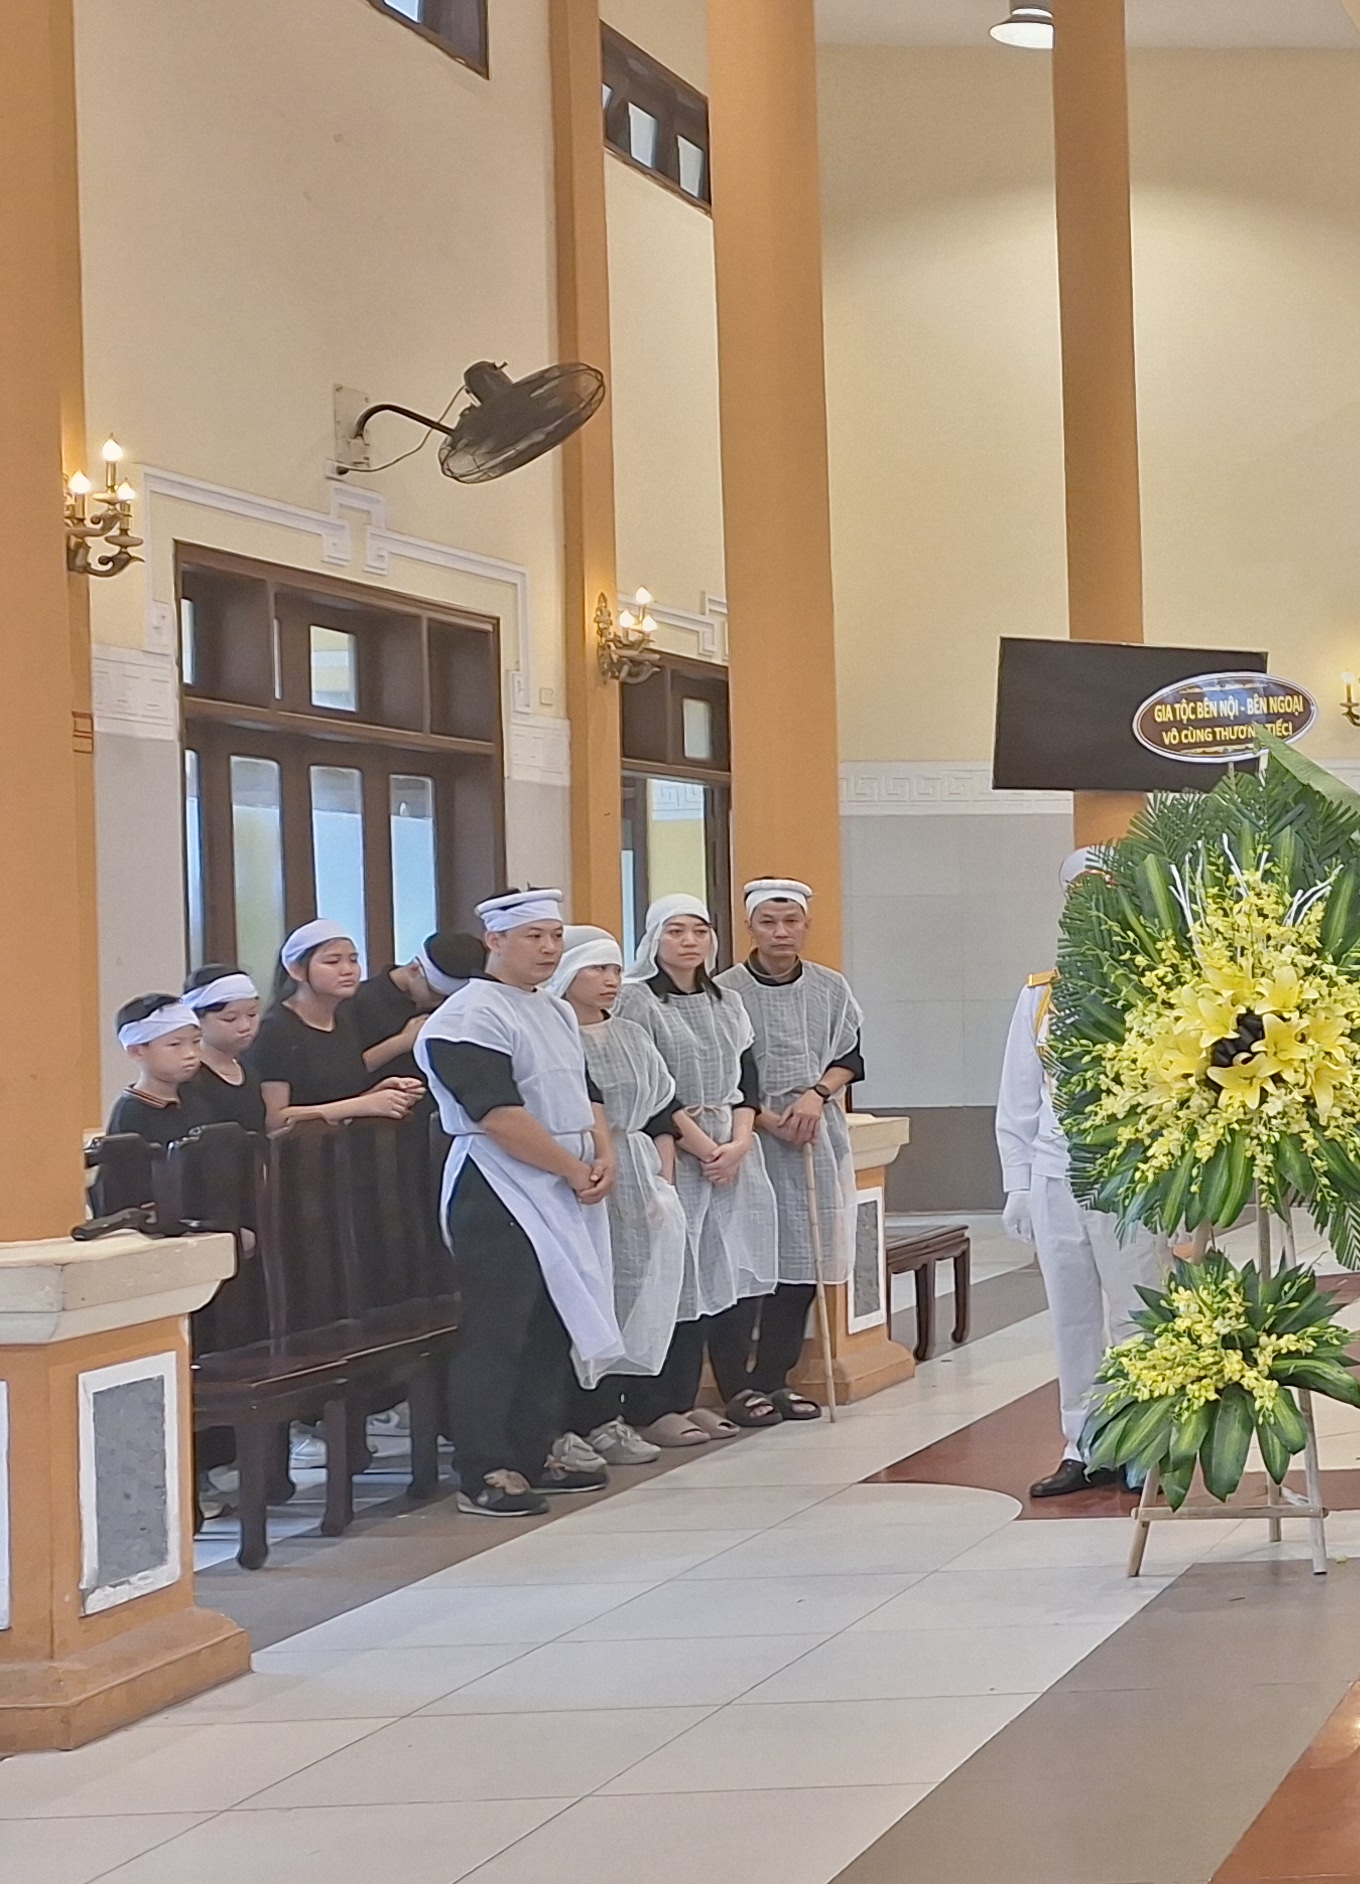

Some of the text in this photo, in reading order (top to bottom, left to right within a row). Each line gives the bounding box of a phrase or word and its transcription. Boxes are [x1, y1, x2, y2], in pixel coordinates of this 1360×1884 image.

[1154, 703, 1174, 723] GIA
[1174, 699, 1196, 723] TỘC
[1196, 697, 1218, 719] BÊN
[1219, 695, 1239, 721] NỘI
[1246, 693, 1267, 715] BÊN
[1269, 694, 1304, 716] NGOẠI
[1162, 727, 1179, 746] VÔ
[1180, 726, 1213, 744] CÙNG
[1213, 723, 1257, 741] THƯƠN
